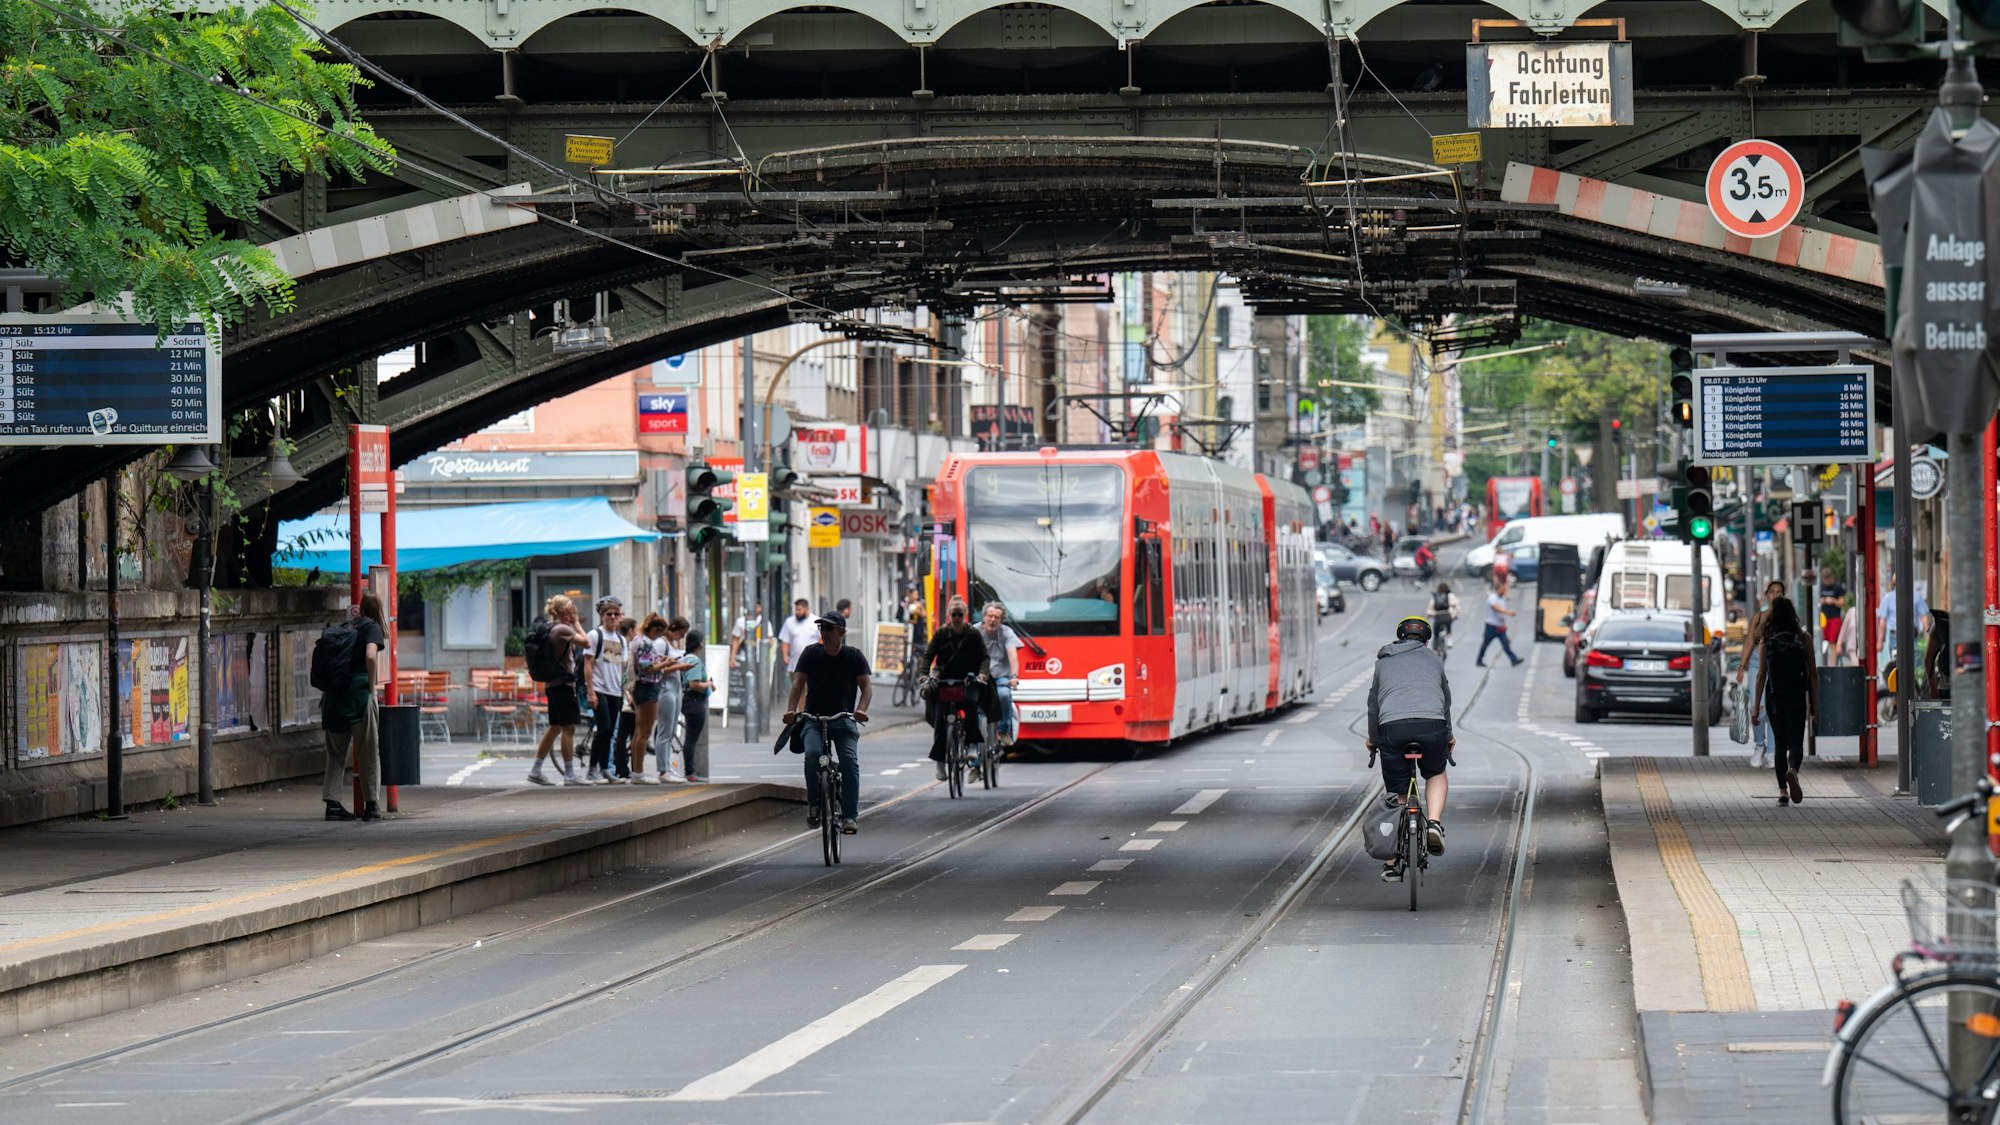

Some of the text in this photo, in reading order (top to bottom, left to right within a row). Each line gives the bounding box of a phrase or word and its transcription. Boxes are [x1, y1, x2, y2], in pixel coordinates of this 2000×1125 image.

[1518, 50, 1604, 79] Achtung
[1926, 234, 1986, 266] Anlage
[1926, 282, 1986, 301] ausser
[1925, 322, 1987, 350] Betrieb
[173, 337, 200, 345] Sofort
[16, 351, 33, 359] Sülz
[16, 364, 34, 372] Sülz
[170, 362, 181, 370] 21
[16, 376, 34, 384] Sülz
[17, 388, 34, 396] Sülz
[17, 400, 34, 408] Sülz
[171, 399, 182, 407] 50
[650, 396, 676, 413] sky
[1725, 405, 1761, 413] Königsforst
[172, 411, 182, 419] 60
[1725, 414, 1761, 422] Königsforst
[648, 418, 678, 429] sport
[15, 425, 28, 433] ein
[31, 424, 47, 433] Taxi
[50, 424, 73, 433] rufen
[113, 424, 127, 432] die
[129, 424, 168, 433] Quittung
[428, 456, 531, 477] Restaurant
[986, 472, 1080, 496] 9 Sülz
[1794, 506, 1821, 540] H
[1025, 662, 1046, 670] KVB
[1031, 711, 1057, 719] 4034
